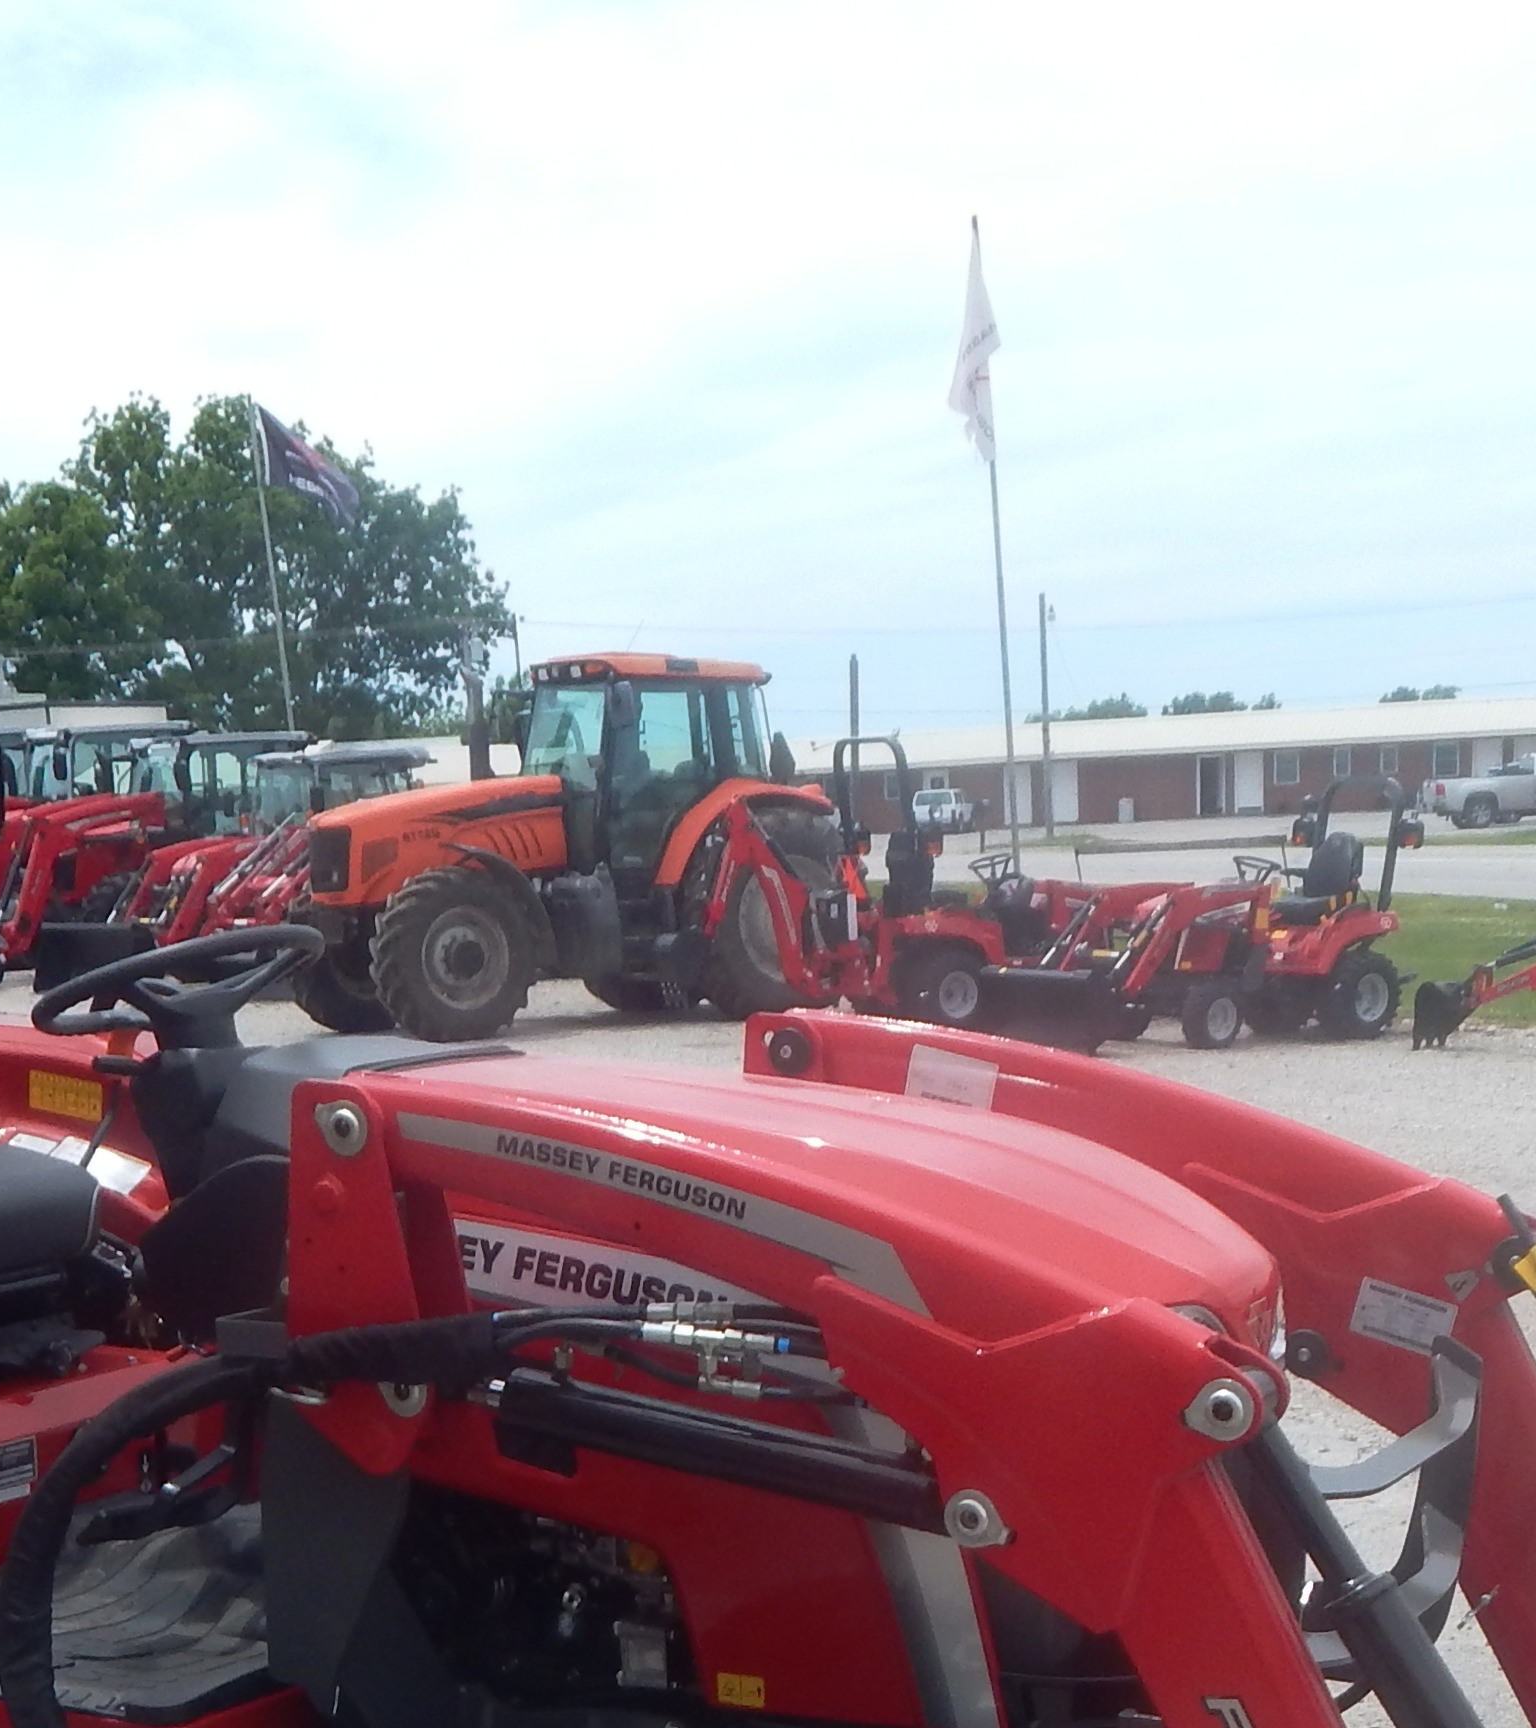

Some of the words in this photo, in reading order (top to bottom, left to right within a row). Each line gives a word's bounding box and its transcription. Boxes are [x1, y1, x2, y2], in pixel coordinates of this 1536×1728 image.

[496, 1134, 601, 1174] MASSEY
[608, 1160, 747, 1220] FERGUSON
[457, 1234, 504, 1275] EY
